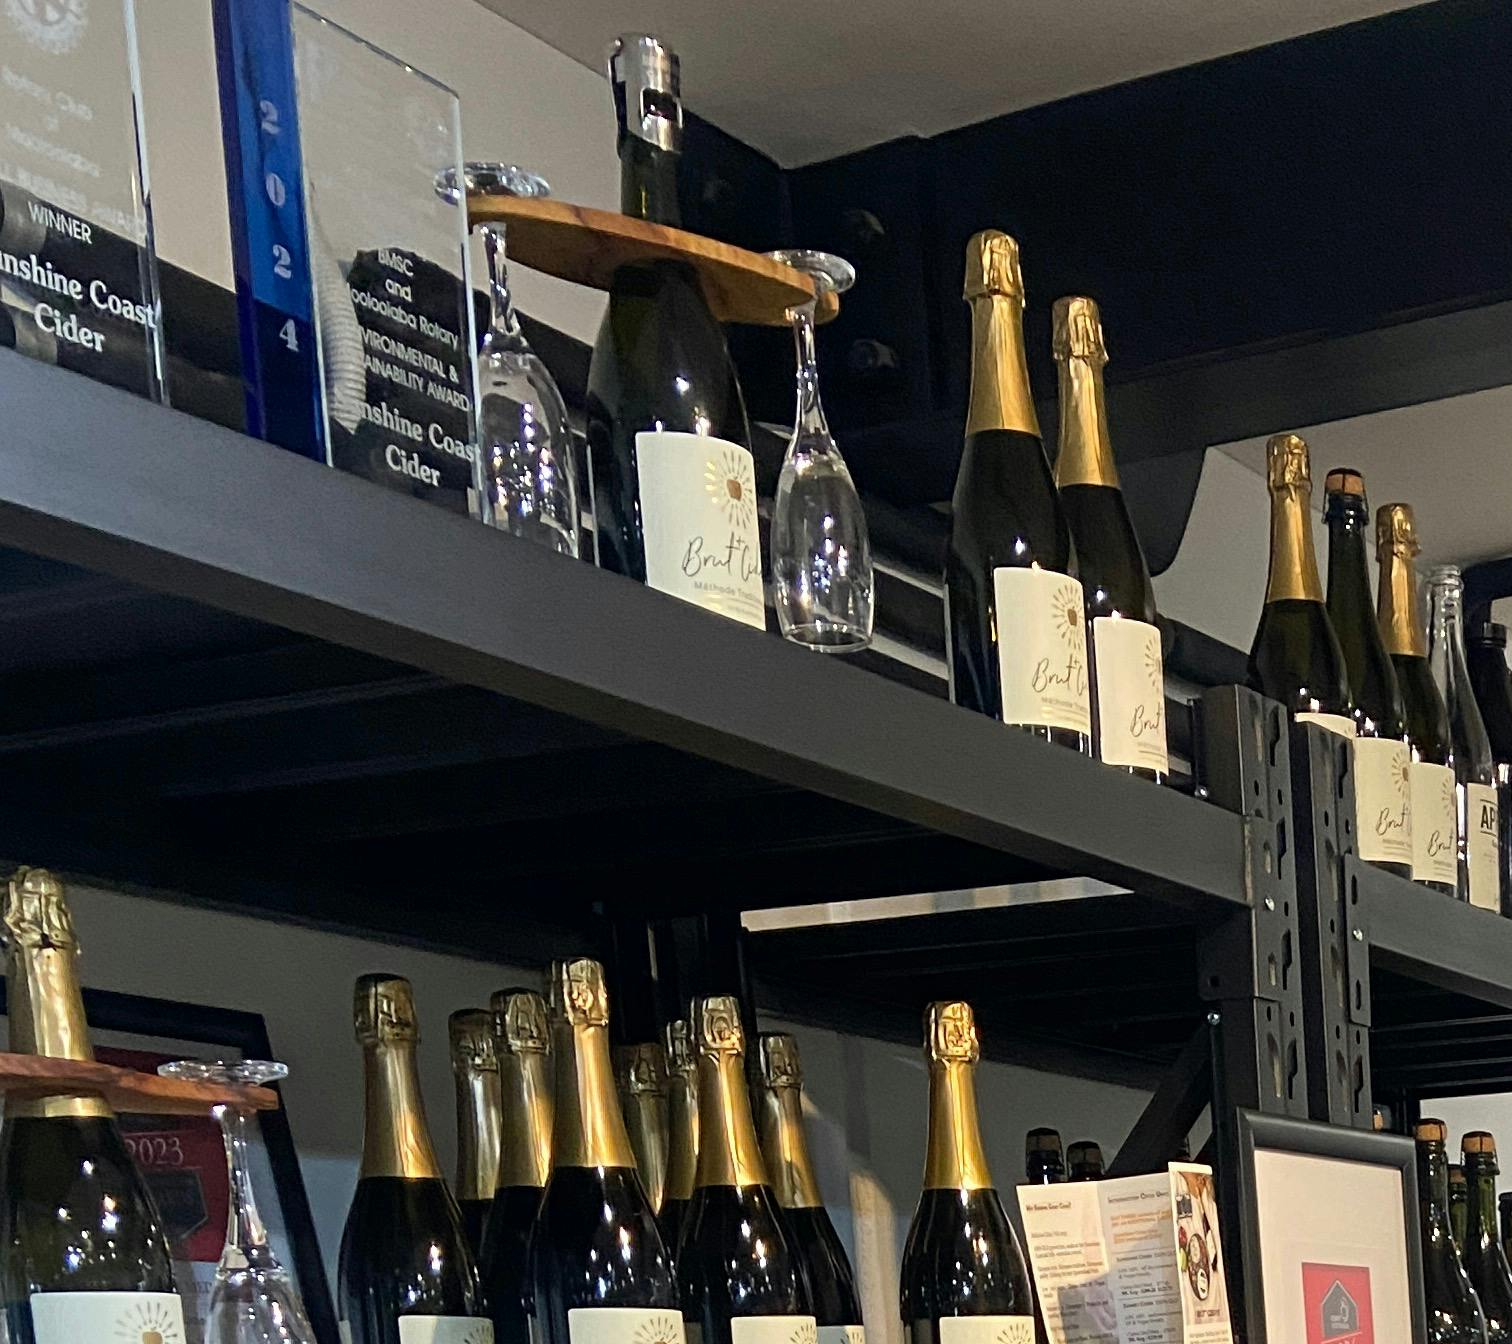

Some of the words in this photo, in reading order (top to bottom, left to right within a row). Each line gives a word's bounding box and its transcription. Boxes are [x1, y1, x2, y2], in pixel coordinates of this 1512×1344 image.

[28, 201, 93, 245] WINNER
[89, 280, 157, 328] Coast
[385, 278, 412, 302] and
[34, 302, 103, 352] Cider
[385, 444, 441, 489] Cider
